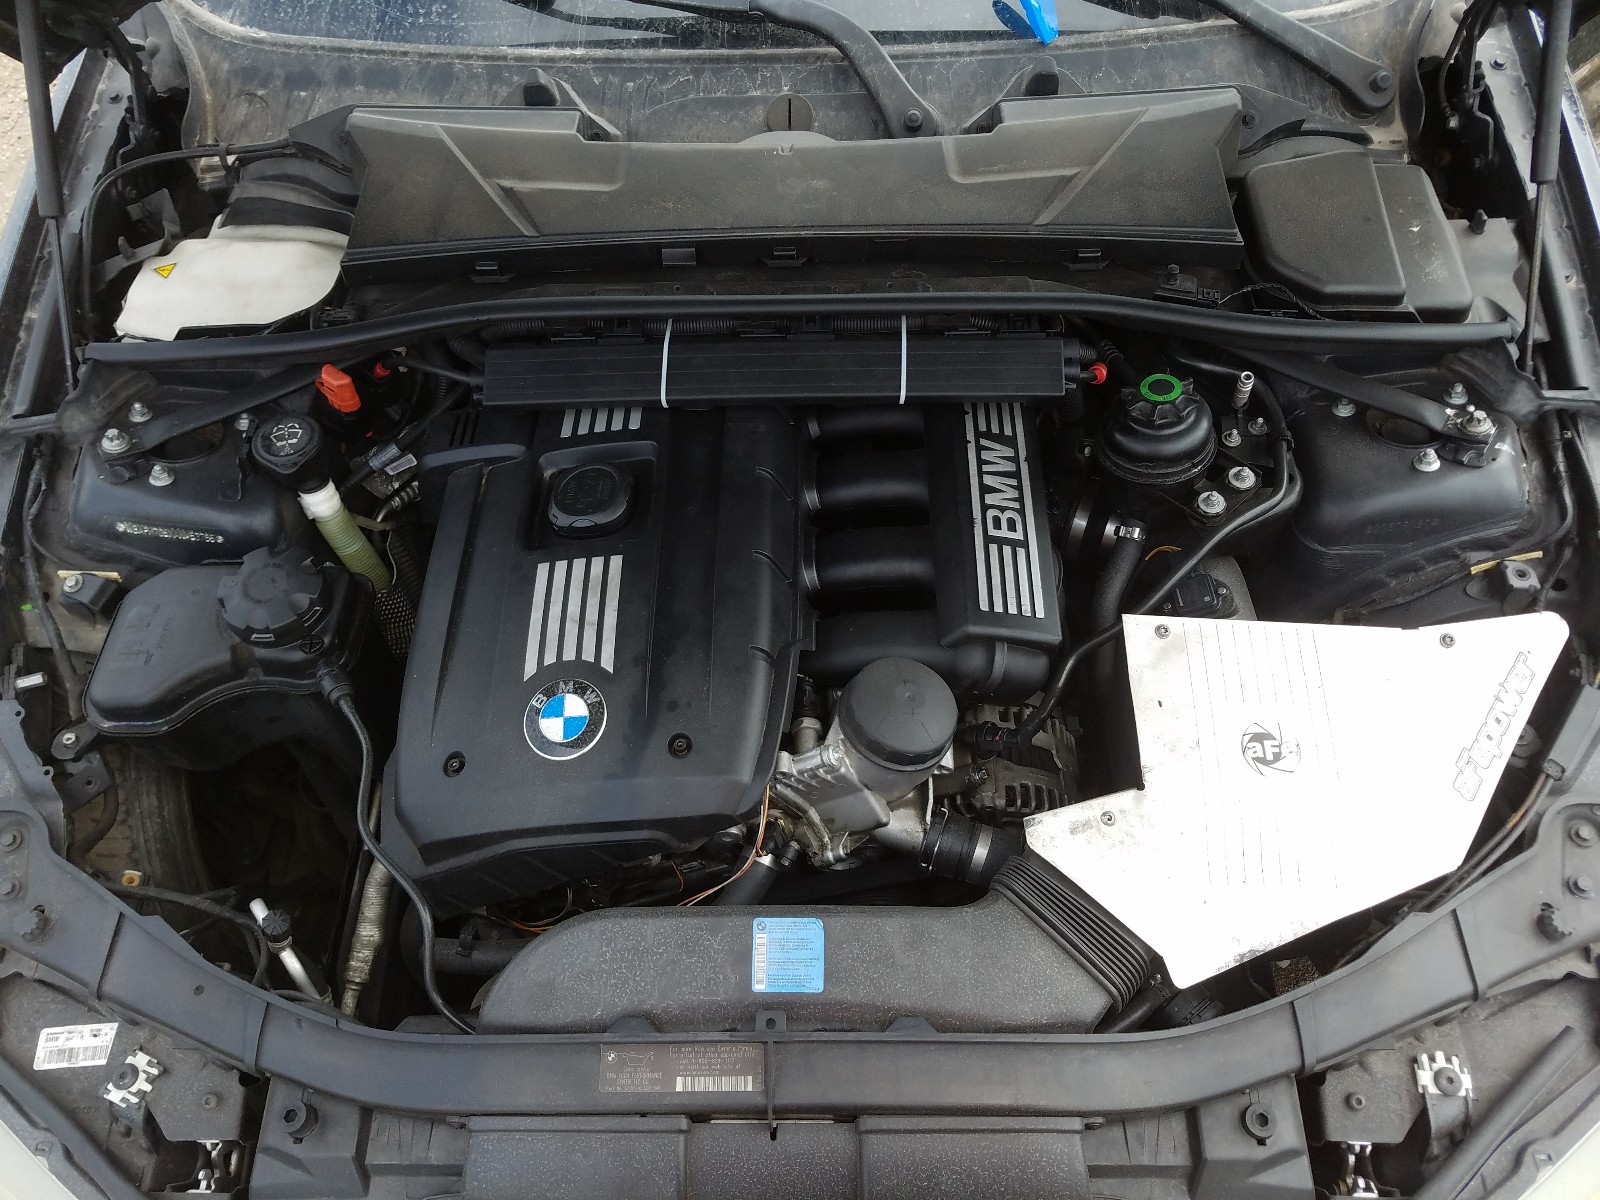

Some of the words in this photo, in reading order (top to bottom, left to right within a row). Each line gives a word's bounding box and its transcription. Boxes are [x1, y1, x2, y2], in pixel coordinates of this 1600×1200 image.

[979, 437, 1024, 541] BMW
[532, 680, 600, 709] BMW
[1245, 739, 1300, 761] aFe
